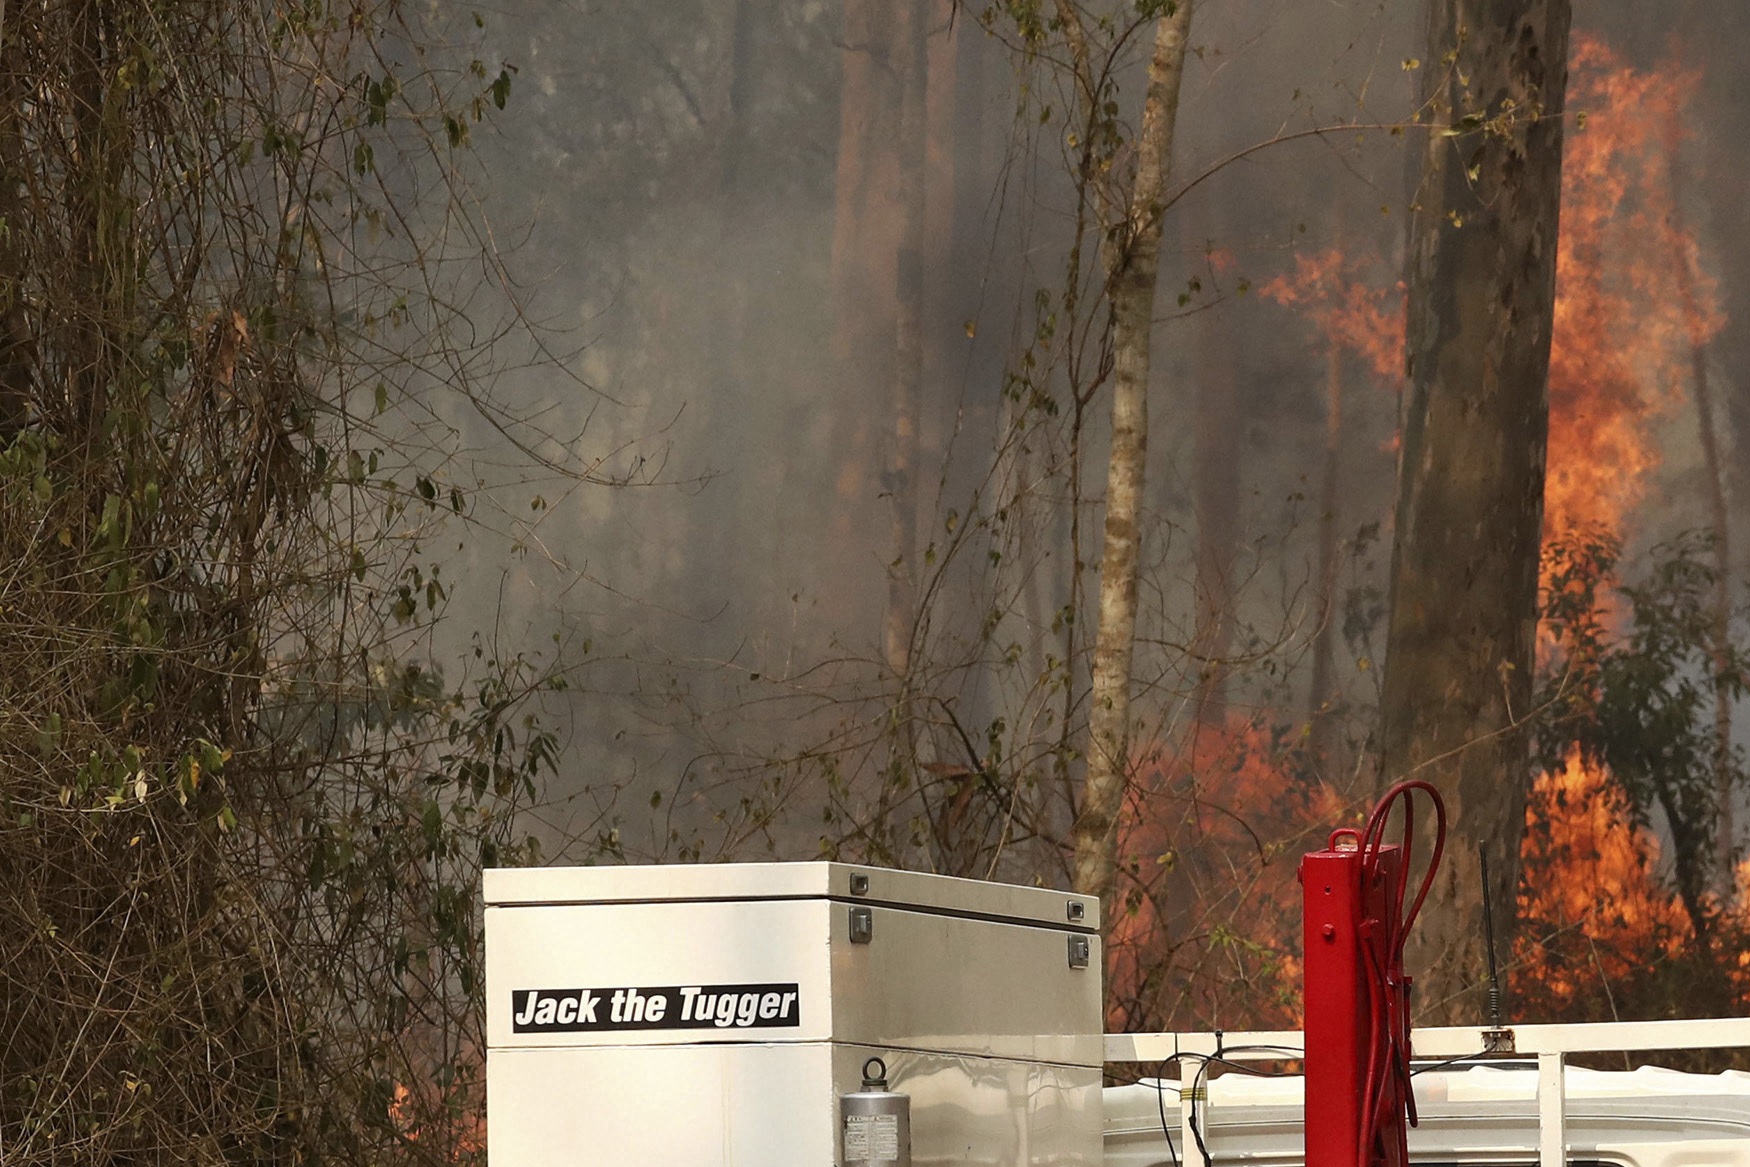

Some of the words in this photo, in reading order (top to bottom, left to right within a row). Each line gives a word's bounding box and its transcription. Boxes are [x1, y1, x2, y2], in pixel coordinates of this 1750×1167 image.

[515, 990, 601, 1026] Jack
[610, 988, 667, 1023] the
[680, 987, 797, 1027] Tugger
